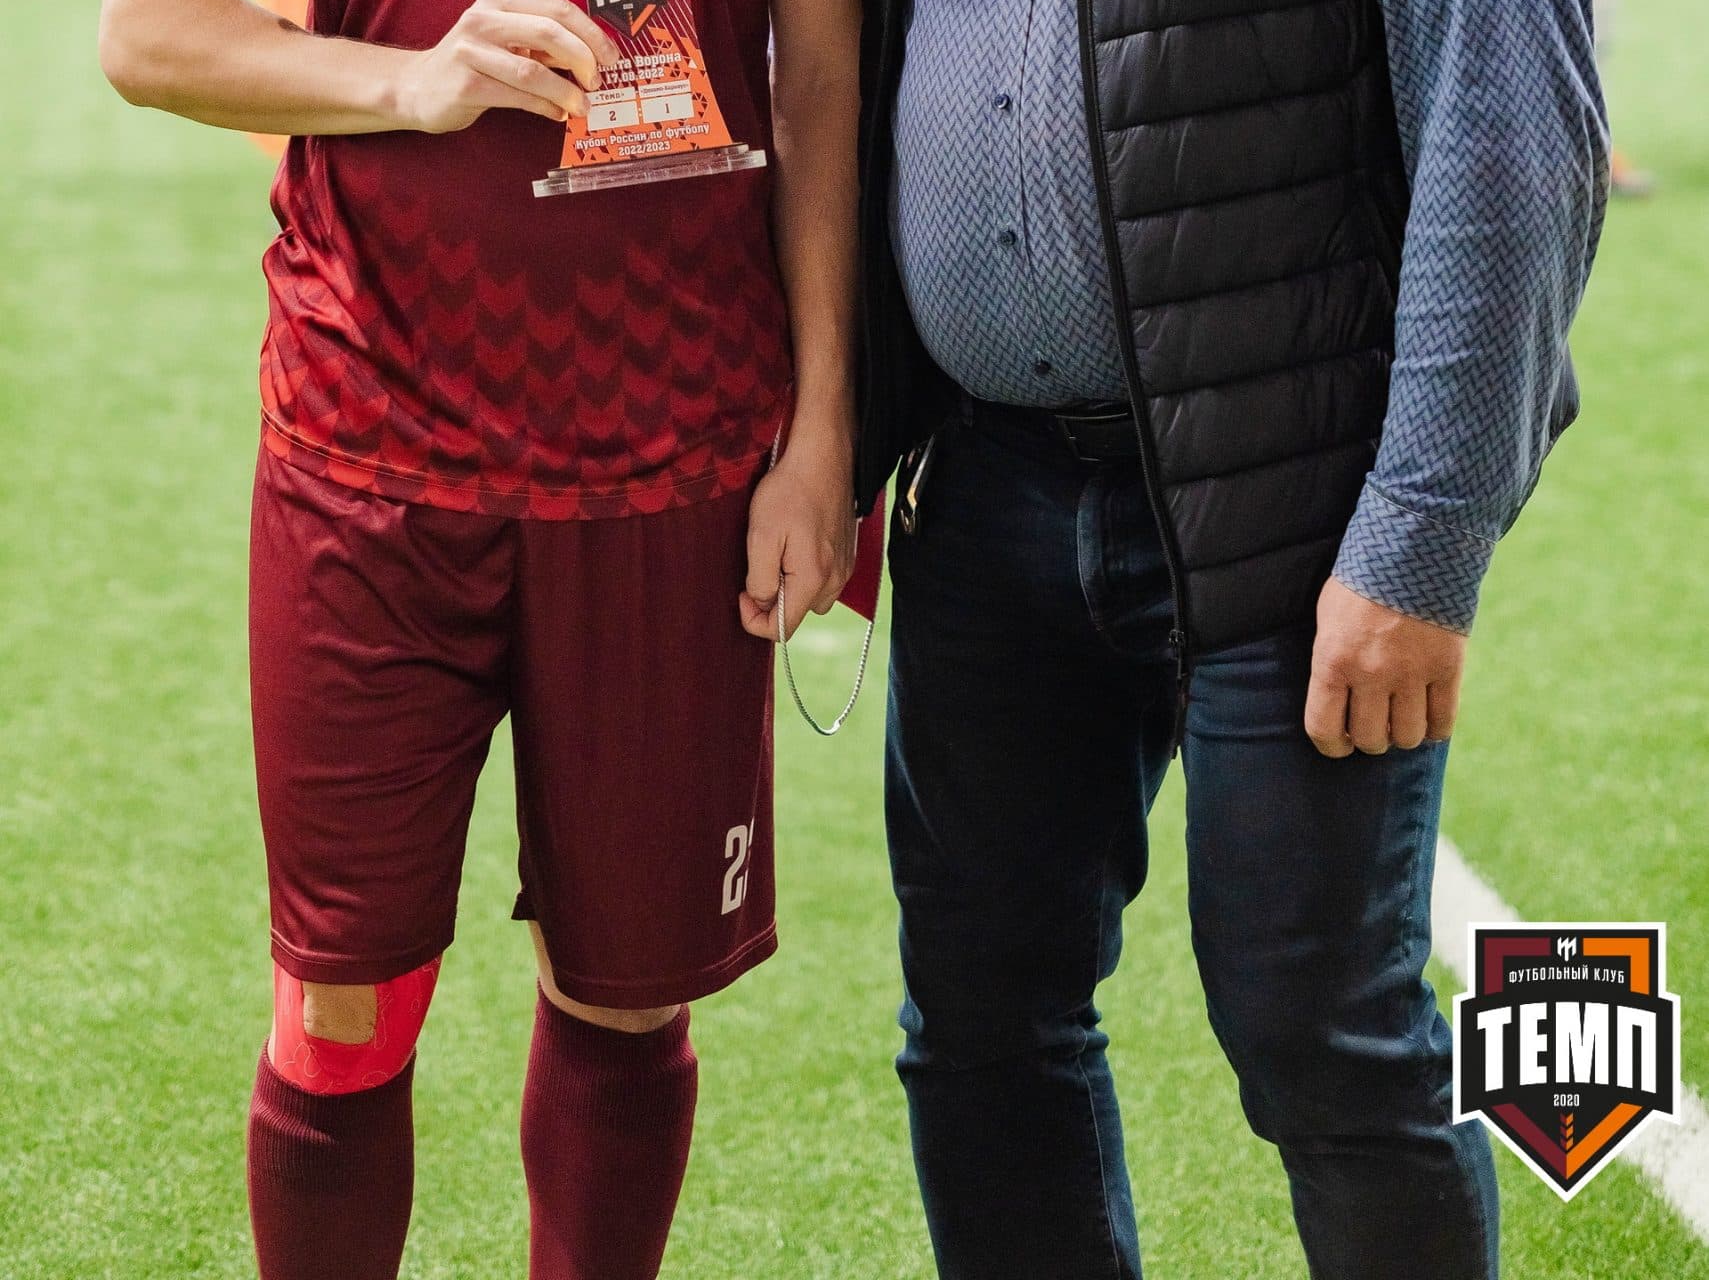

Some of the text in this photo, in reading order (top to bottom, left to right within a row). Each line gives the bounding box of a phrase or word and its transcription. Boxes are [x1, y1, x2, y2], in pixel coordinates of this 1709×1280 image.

[634, 52, 681, 68] Ворона
[609, 103, 670, 122] 2 1
[576, 124, 710, 151] Кубок России по футболу
[619, 141, 671, 156] 2022/2023
[721, 821, 755, 916] 2
